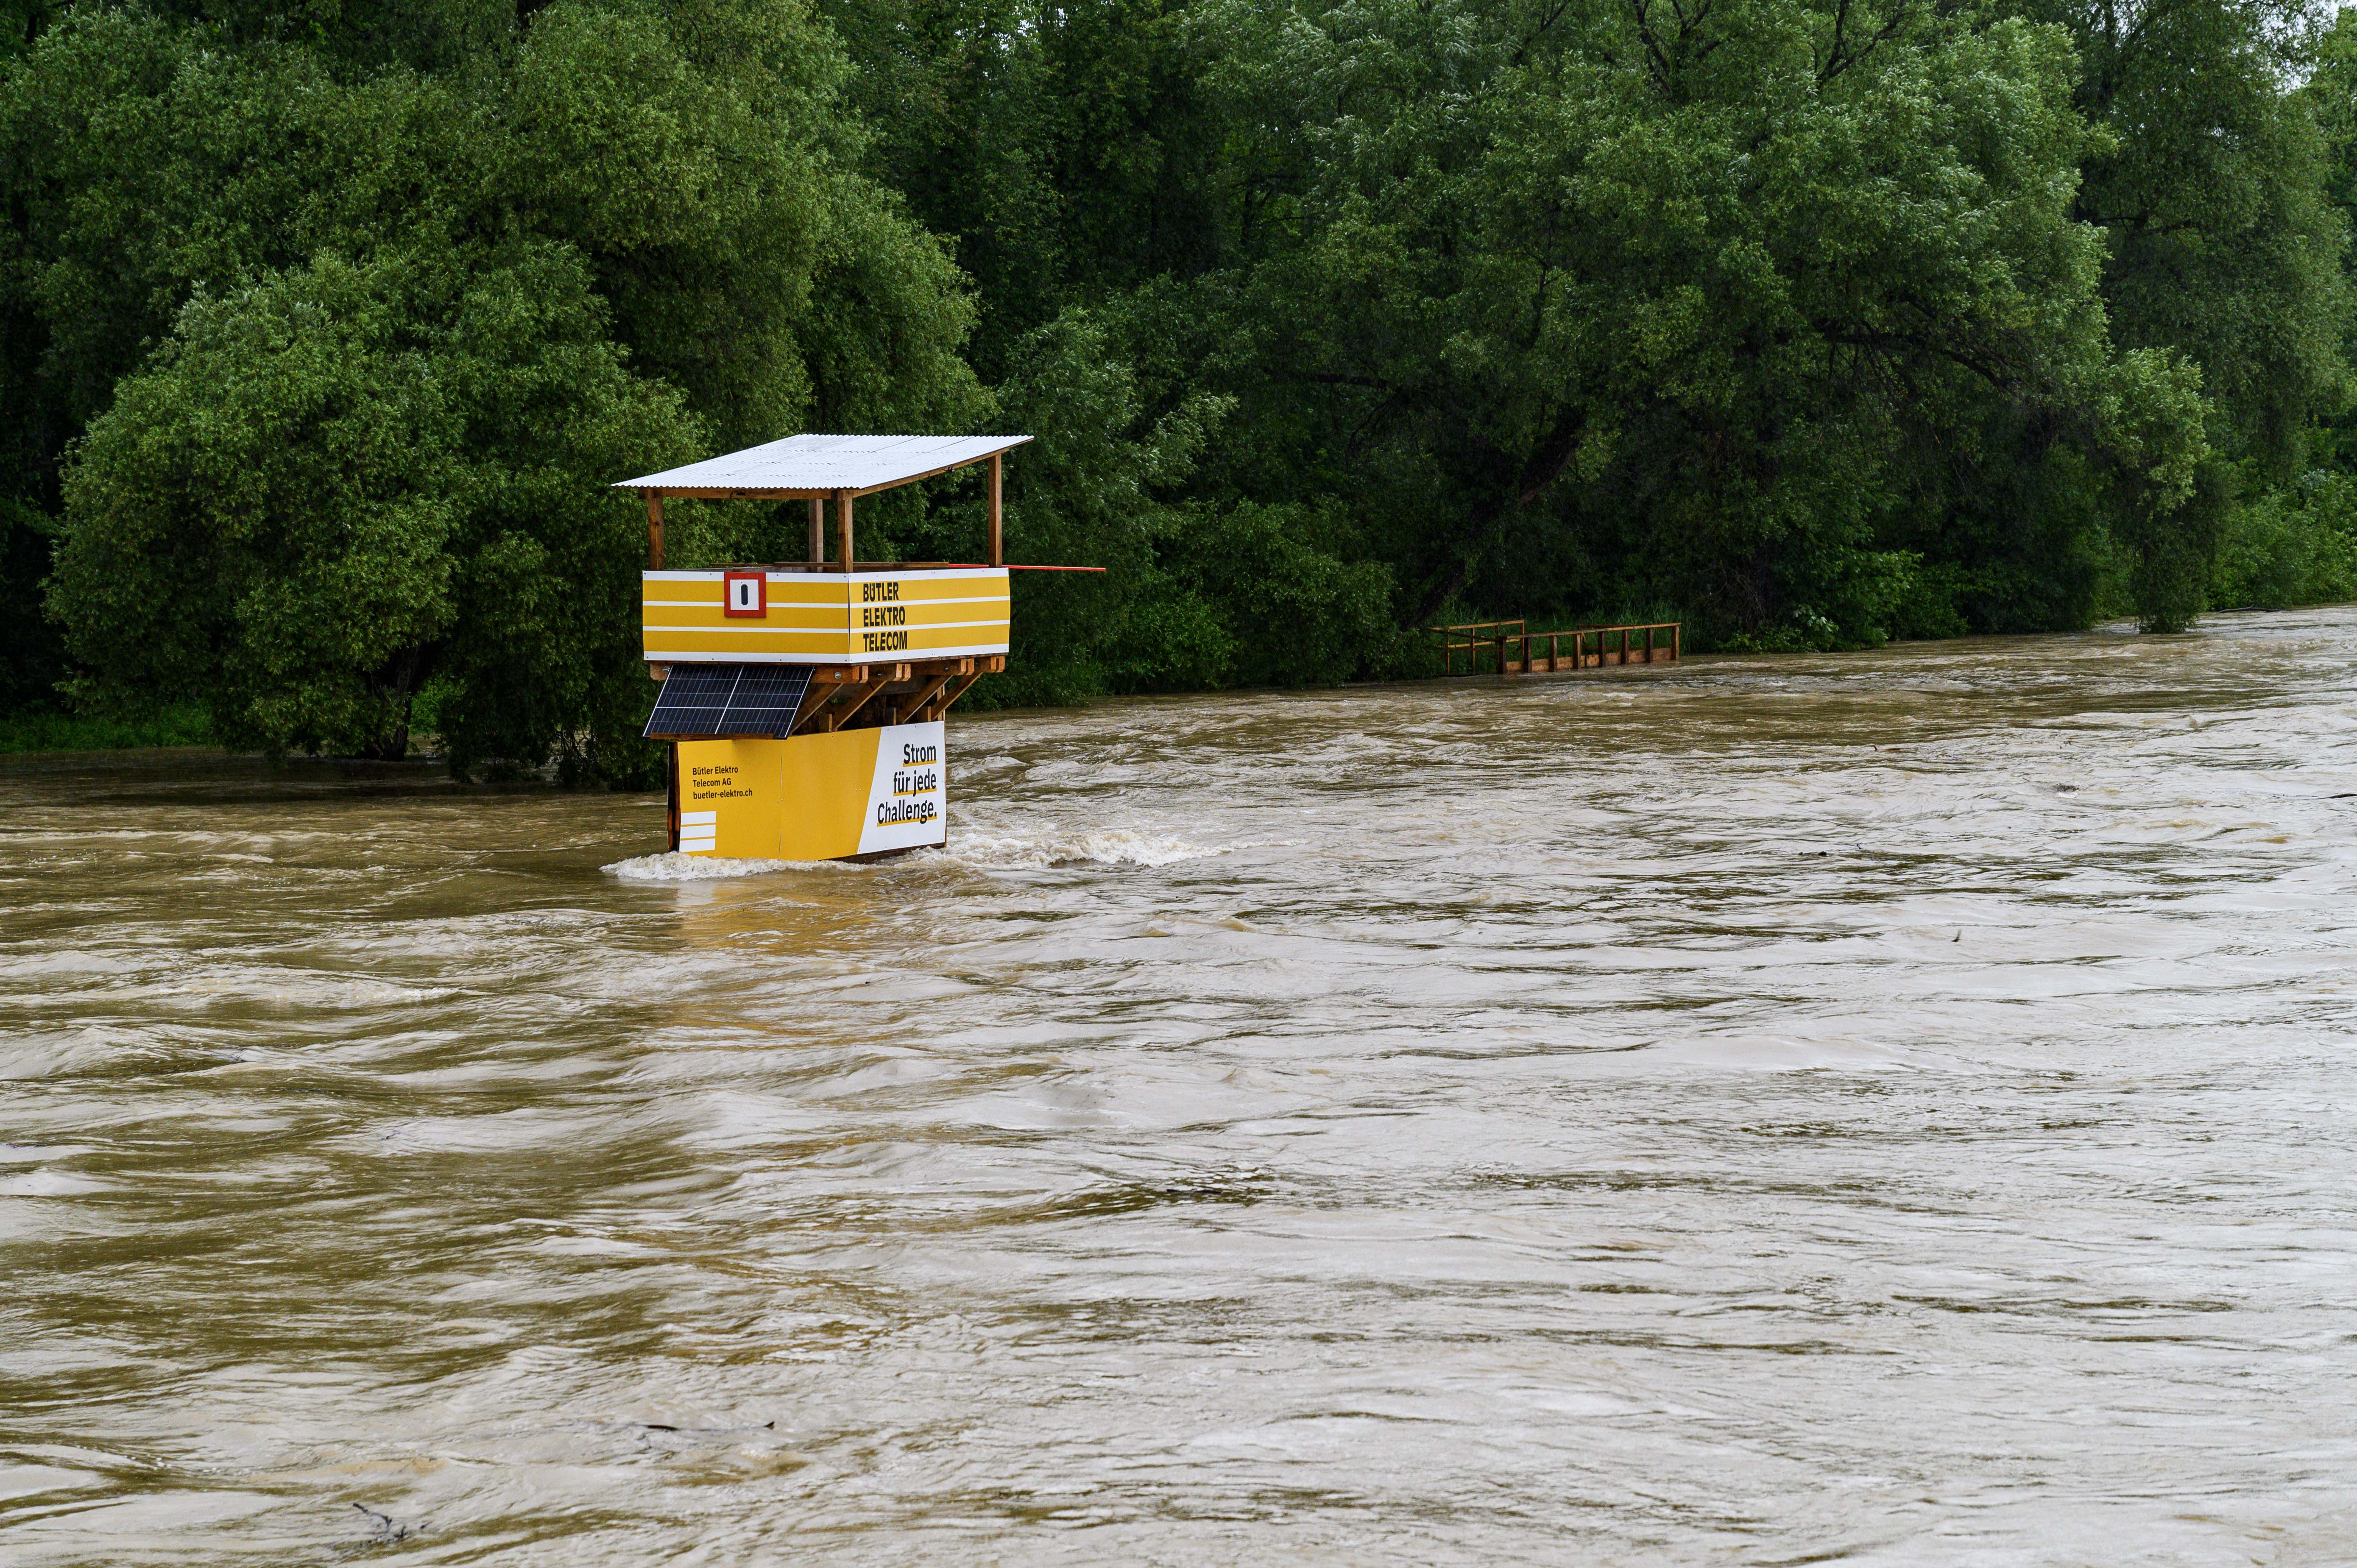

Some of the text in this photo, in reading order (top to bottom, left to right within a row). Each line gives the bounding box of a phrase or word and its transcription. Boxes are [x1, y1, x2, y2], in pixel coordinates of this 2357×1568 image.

[863, 582, 899, 602] BÜTLER
[863, 606, 905, 627] ELEKTRO
[863, 631, 908, 652] TELECOM
[903, 743, 936, 765] Strom
[693, 766, 738, 775] Bütler Elektro
[693, 779, 720, 787] Telecom
[893, 768, 936, 797] für jede
[693, 788, 753, 799] buetler-elektro.ch
[878, 799, 937, 824] Challenge.
